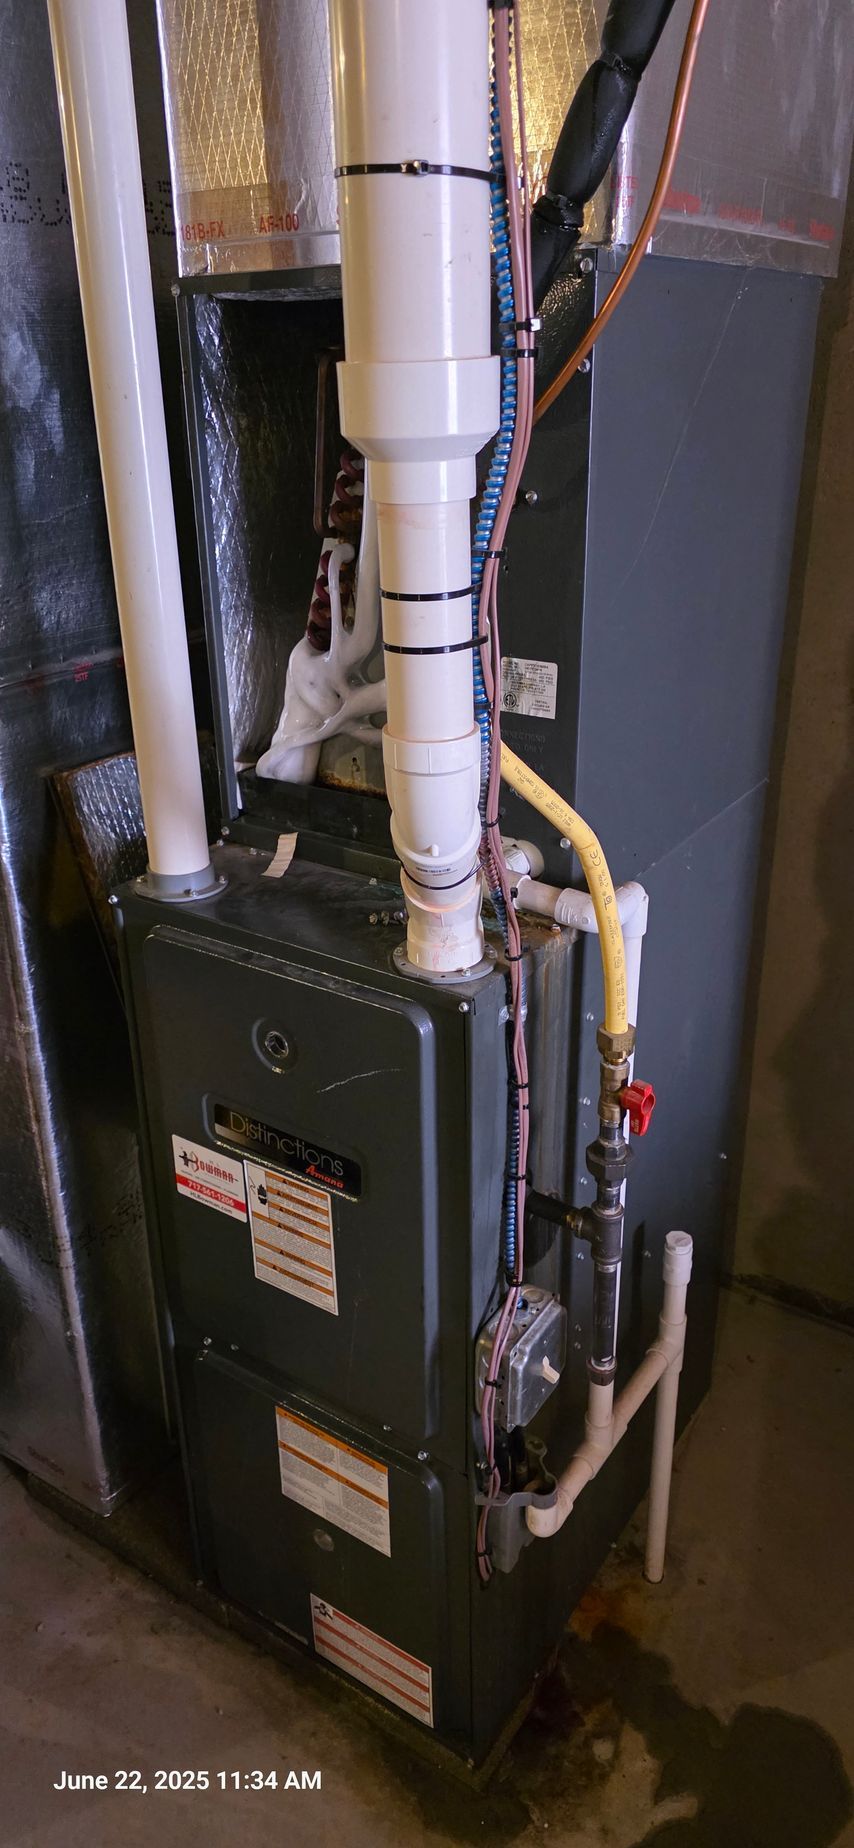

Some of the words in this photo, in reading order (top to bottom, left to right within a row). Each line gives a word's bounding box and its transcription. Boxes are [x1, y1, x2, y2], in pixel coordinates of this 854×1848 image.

[259, 213, 300, 234] AF-100
[229, 1111, 344, 1177] Distinctions
[305, 1164, 344, 1189] Amana
[187, 1180, 235, 1207] 717-561-1206
